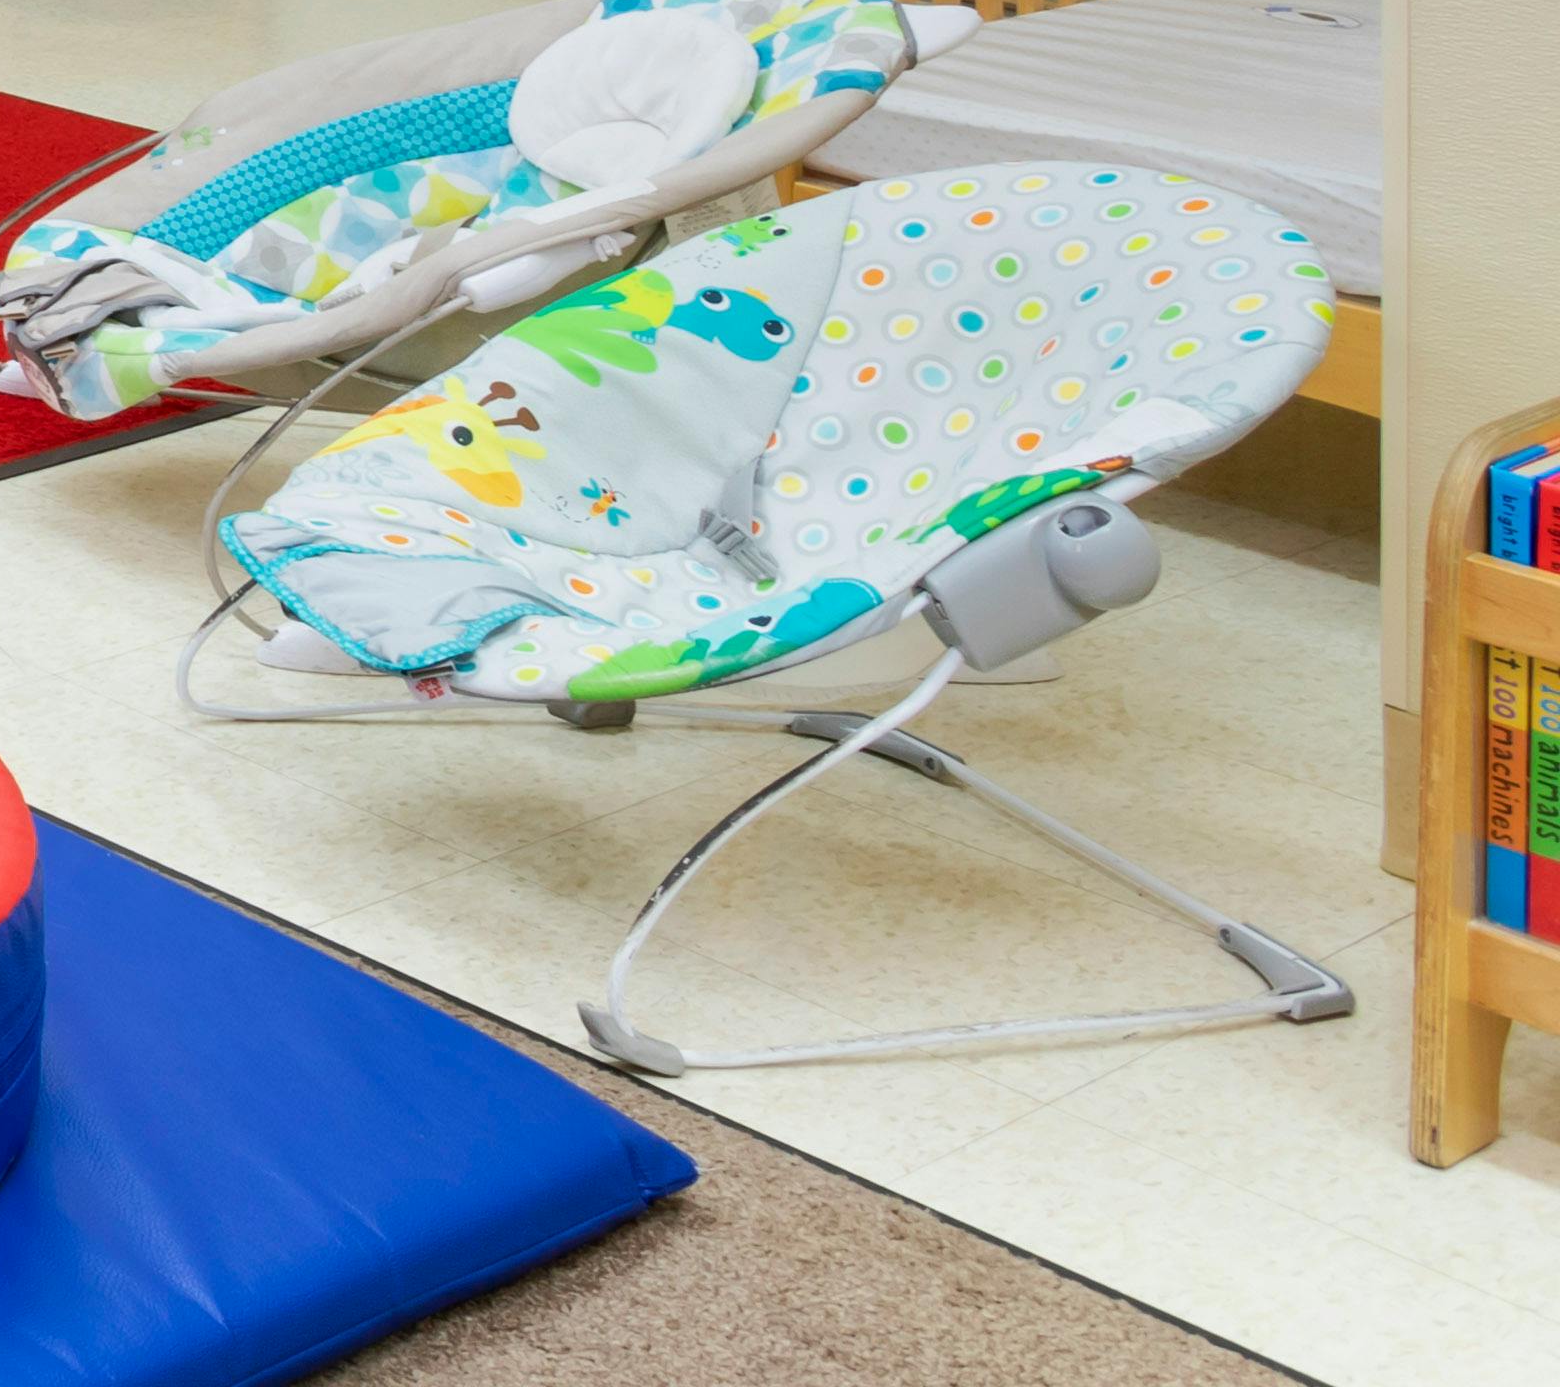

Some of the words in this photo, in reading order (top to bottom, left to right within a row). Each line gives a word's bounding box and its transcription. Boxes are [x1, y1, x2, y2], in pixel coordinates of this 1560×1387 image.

[1497, 493, 1519, 545] bright
[1493, 674, 1519, 720] 100
[1539, 683, 1560, 734] 100
[1491, 723, 1522, 846] machines
